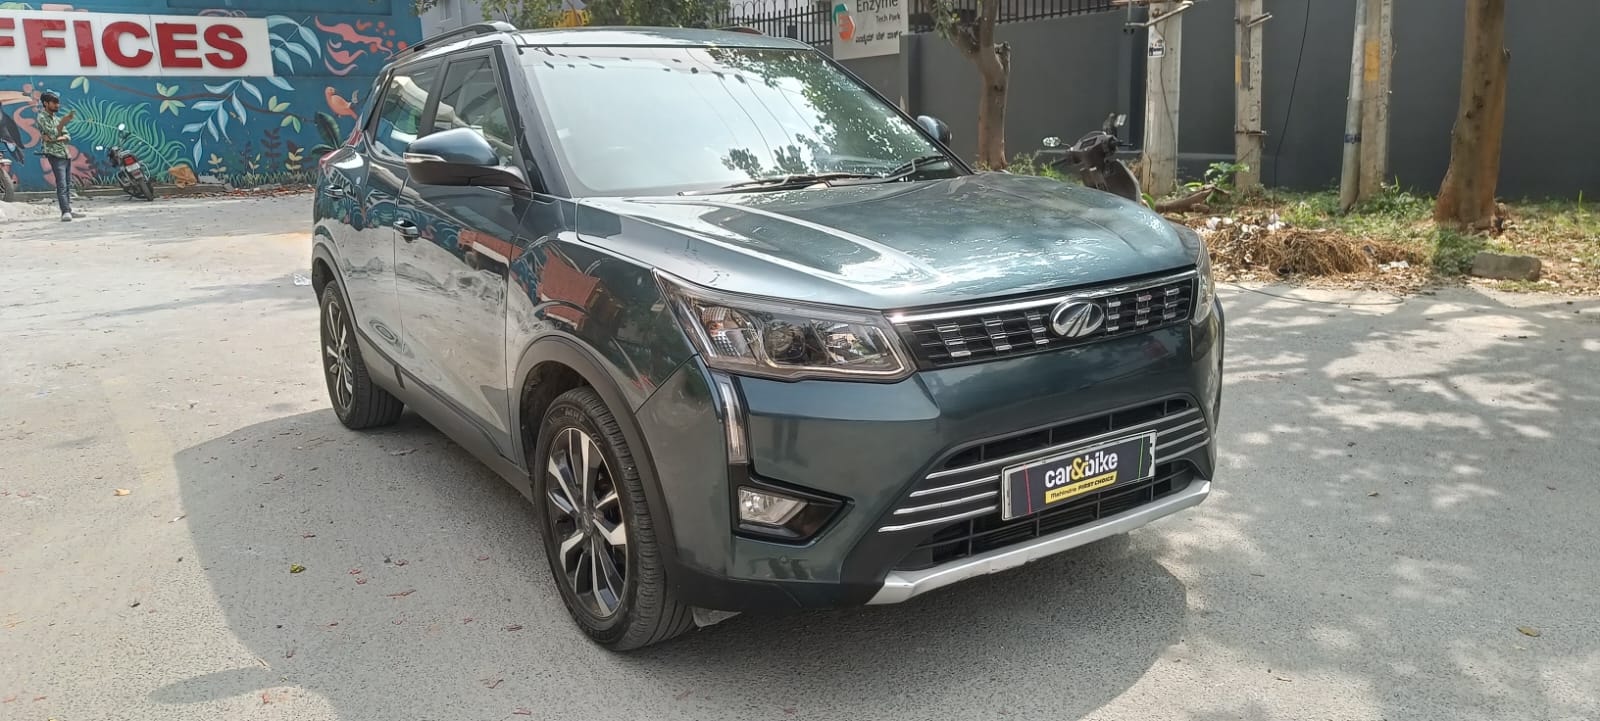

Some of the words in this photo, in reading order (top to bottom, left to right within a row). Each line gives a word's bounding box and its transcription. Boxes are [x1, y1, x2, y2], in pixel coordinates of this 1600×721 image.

[856, 0, 898, 13] Enzyme
[876, 14, 888, 23] Tech
[889, 12, 901, 21] Park
[1045, 451, 1118, 488] car&bike
[1078, 481, 1094, 490] FIRST
[1095, 475, 1114, 486] CHOICE
